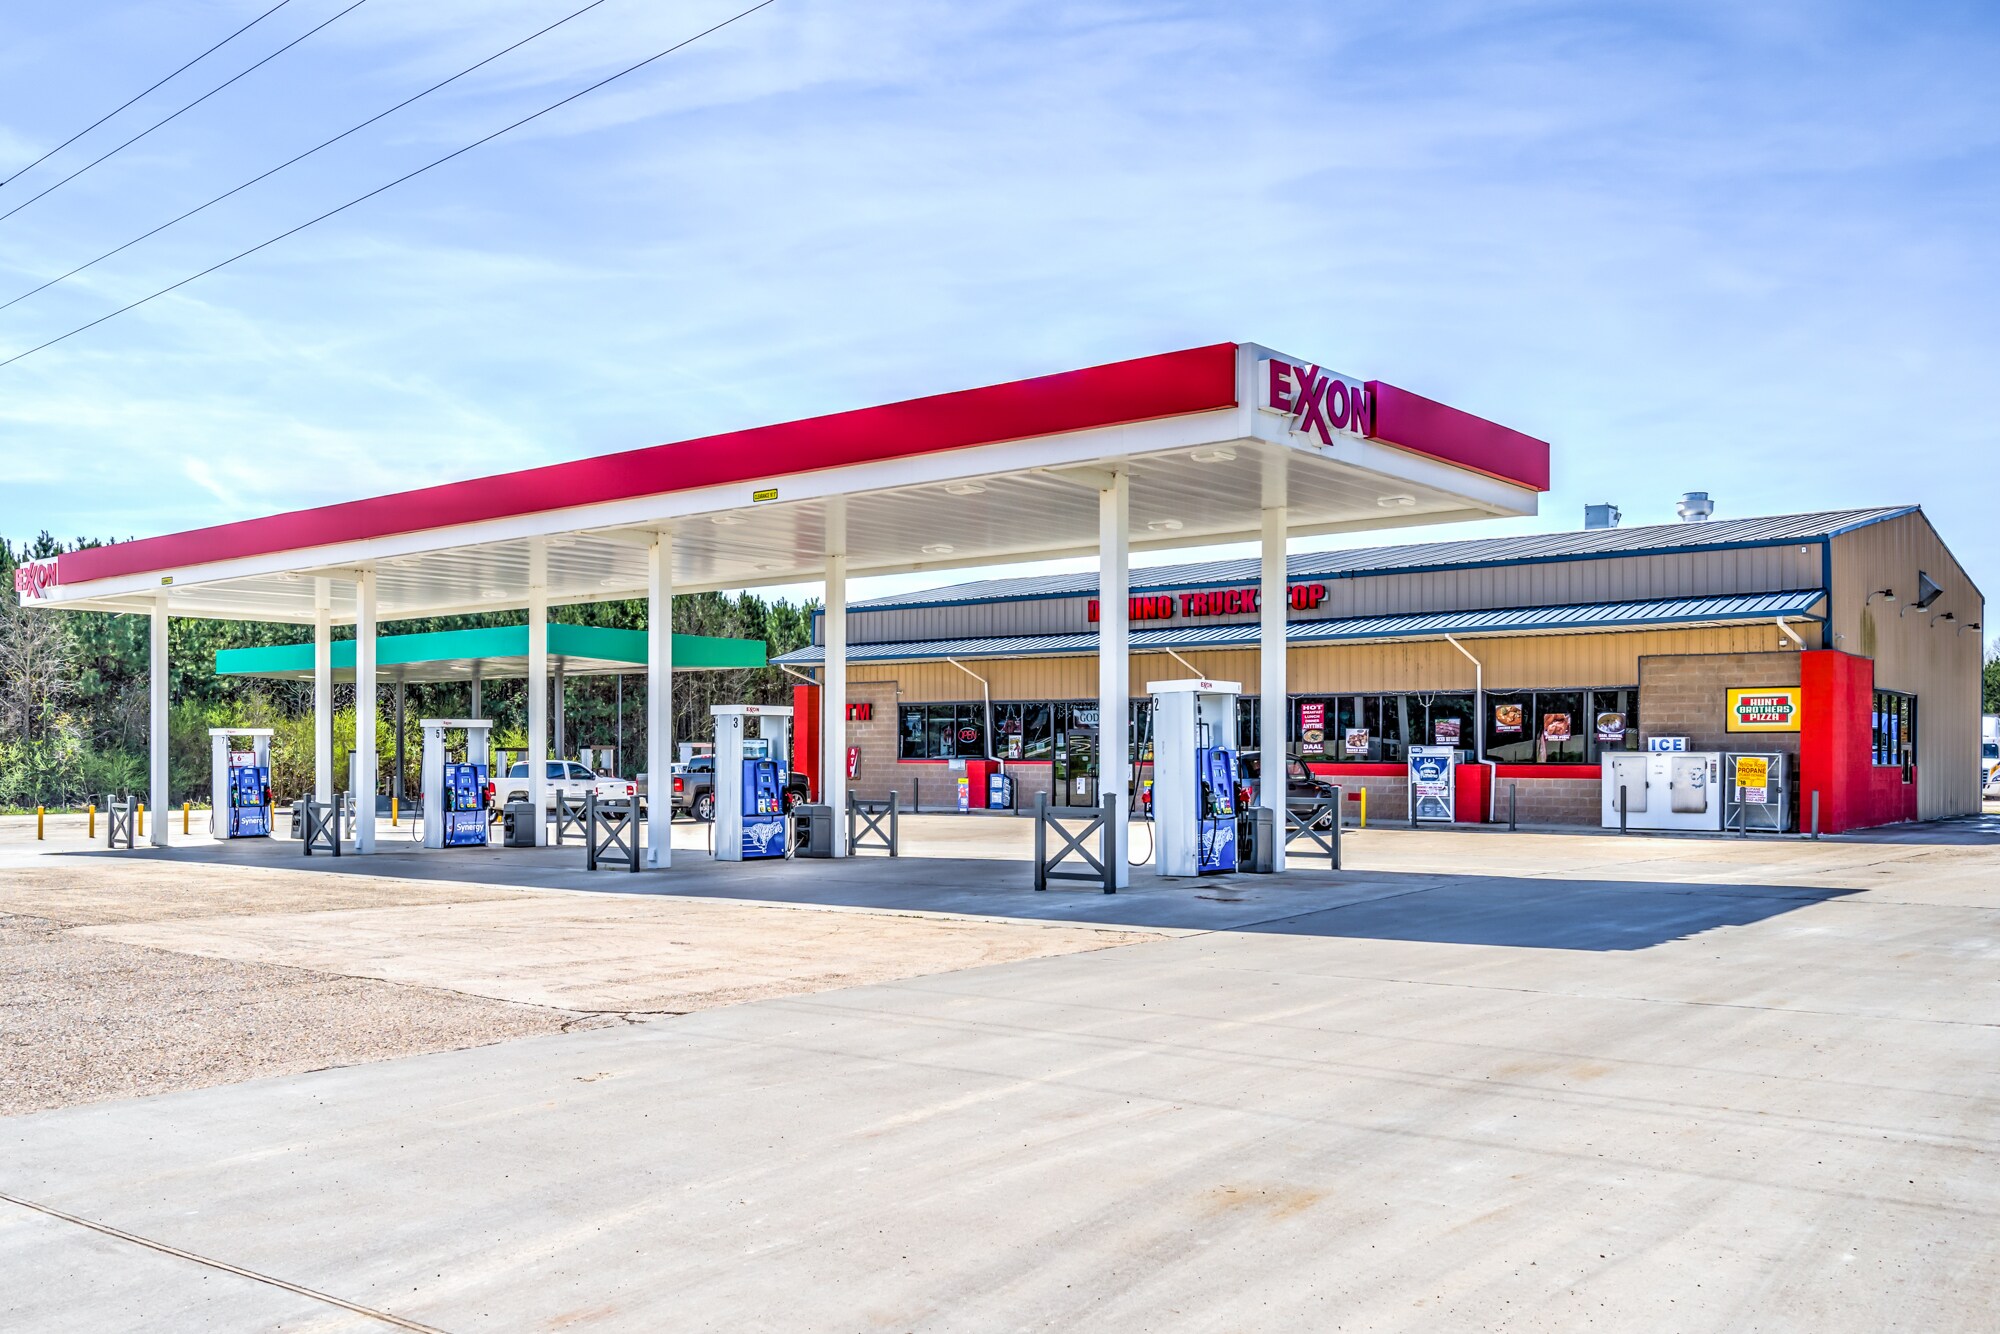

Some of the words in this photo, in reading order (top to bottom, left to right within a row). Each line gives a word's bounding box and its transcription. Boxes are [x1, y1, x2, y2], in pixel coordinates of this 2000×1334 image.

[1269, 358, 1371, 446] EXXON
[15, 562, 57, 598] EXXON
[1178, 588, 1259, 618] TRUCK
[1154, 698, 1159, 711] 2
[1750, 698, 1779, 706] HUNT
[846, 704, 871, 720] TM
[1749, 713, 1779, 721] PIZZA
[733, 717, 739, 728] 3
[435, 729, 440, 739] 5
[221, 736, 225, 745] 7
[1651, 739, 1682, 751] ICE
[456, 822, 484, 833] Synergy
